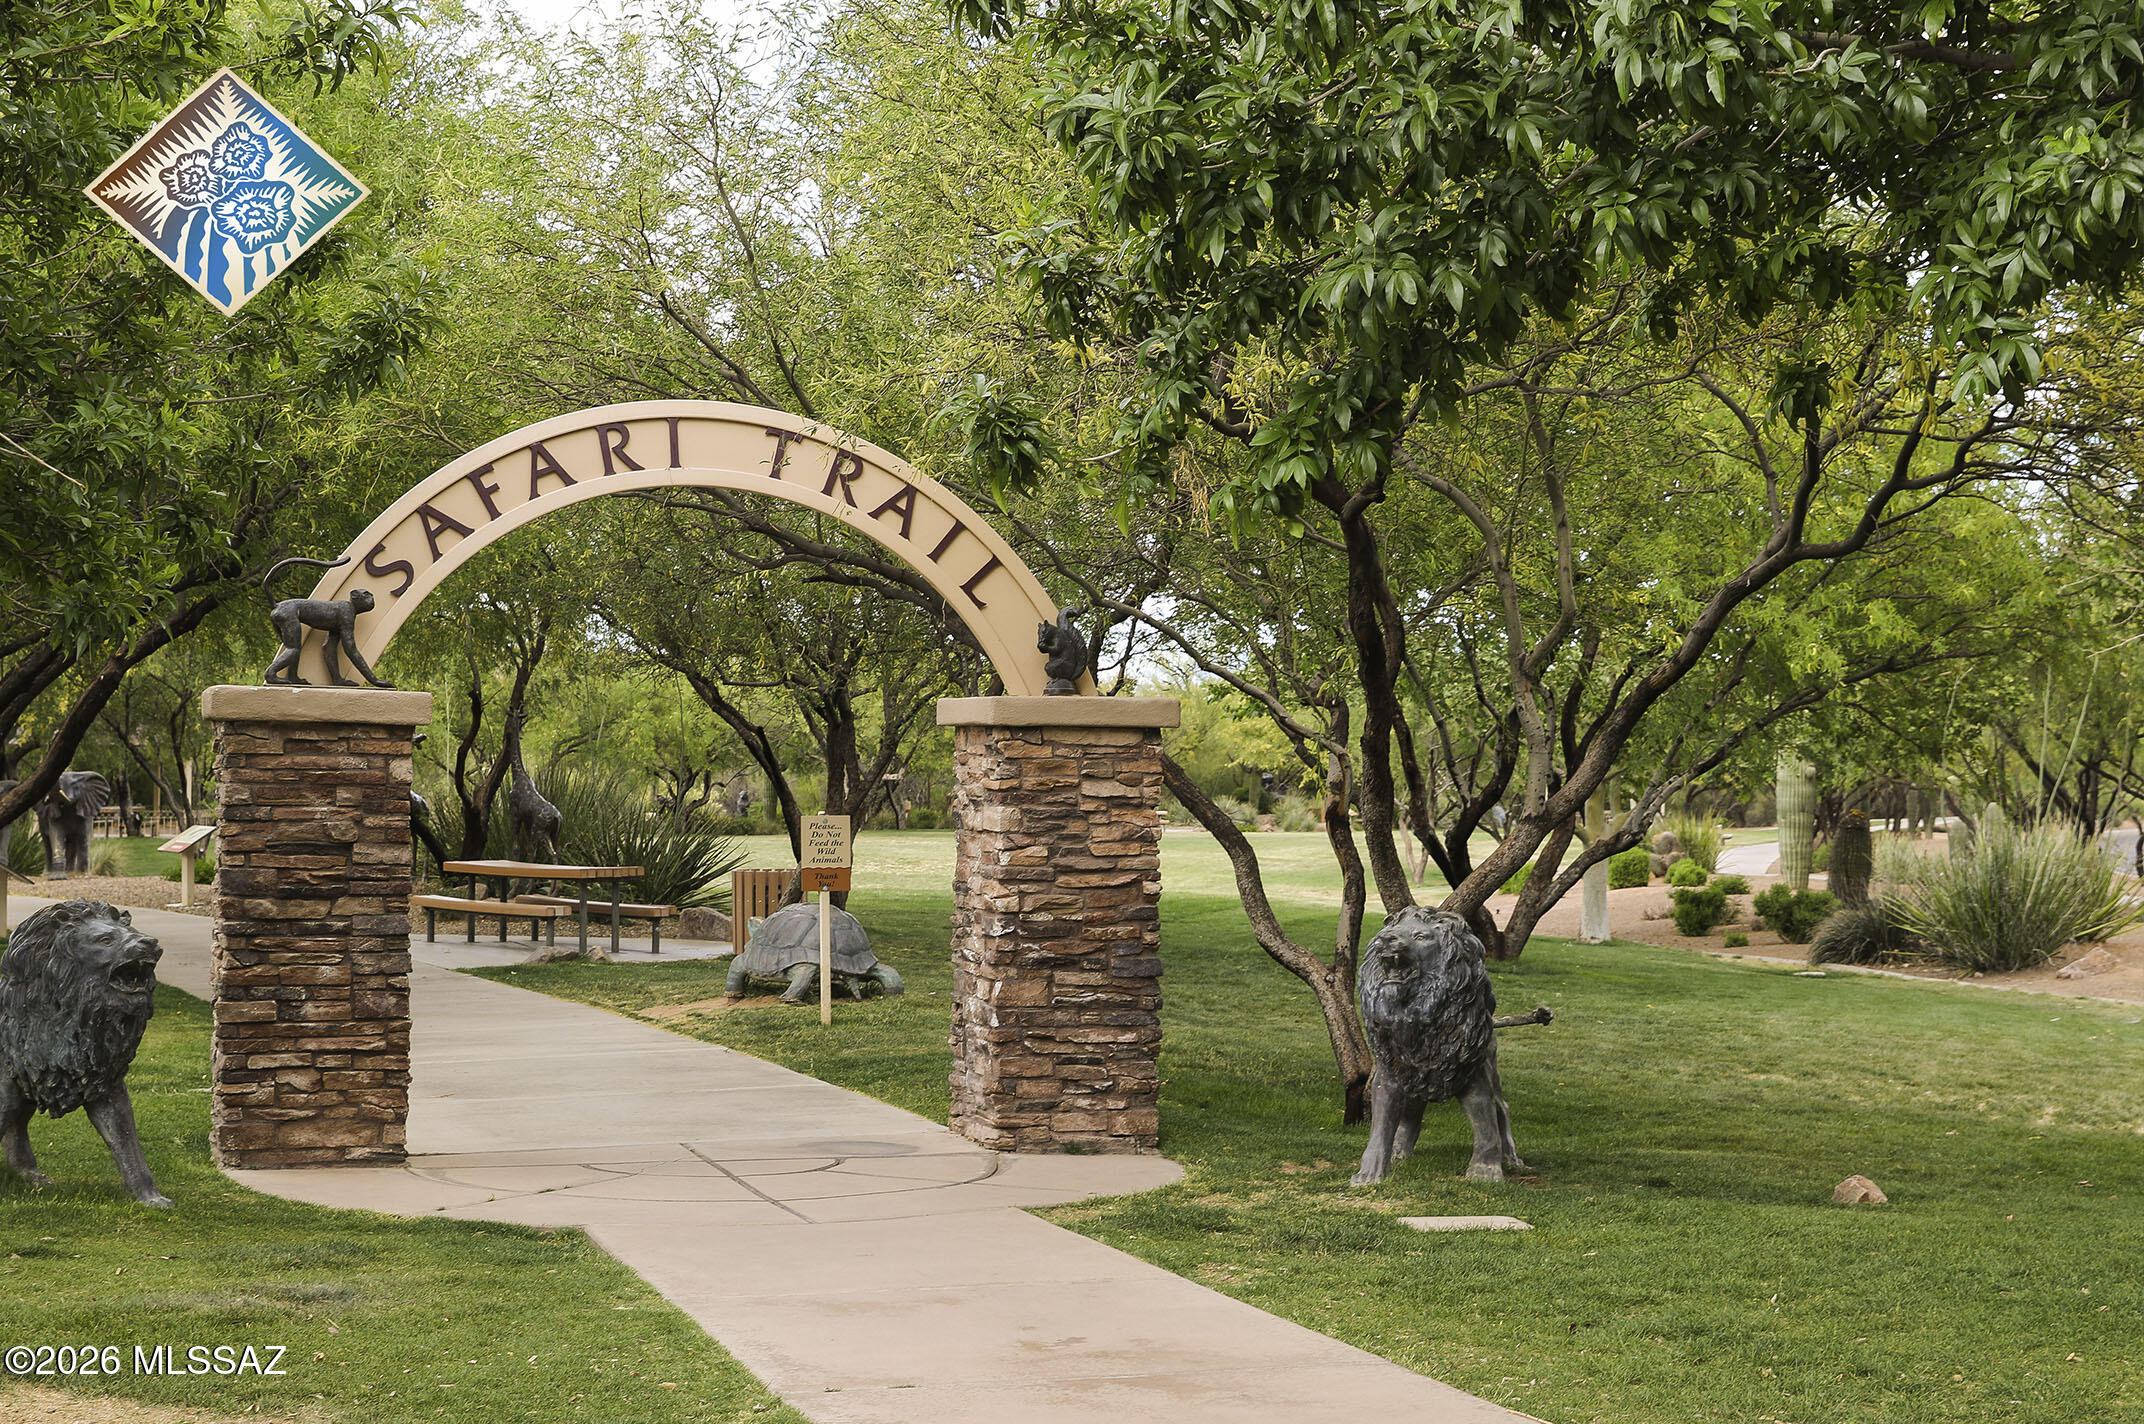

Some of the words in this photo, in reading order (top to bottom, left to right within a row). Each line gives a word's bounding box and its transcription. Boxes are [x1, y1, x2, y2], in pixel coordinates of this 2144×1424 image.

[364, 416, 682, 598] SAFARI
[764, 426, 1001, 611] TRAIL
[809, 839, 830, 847] Feed
[831, 839, 845, 847] the
[809, 856, 843, 864] Animals
